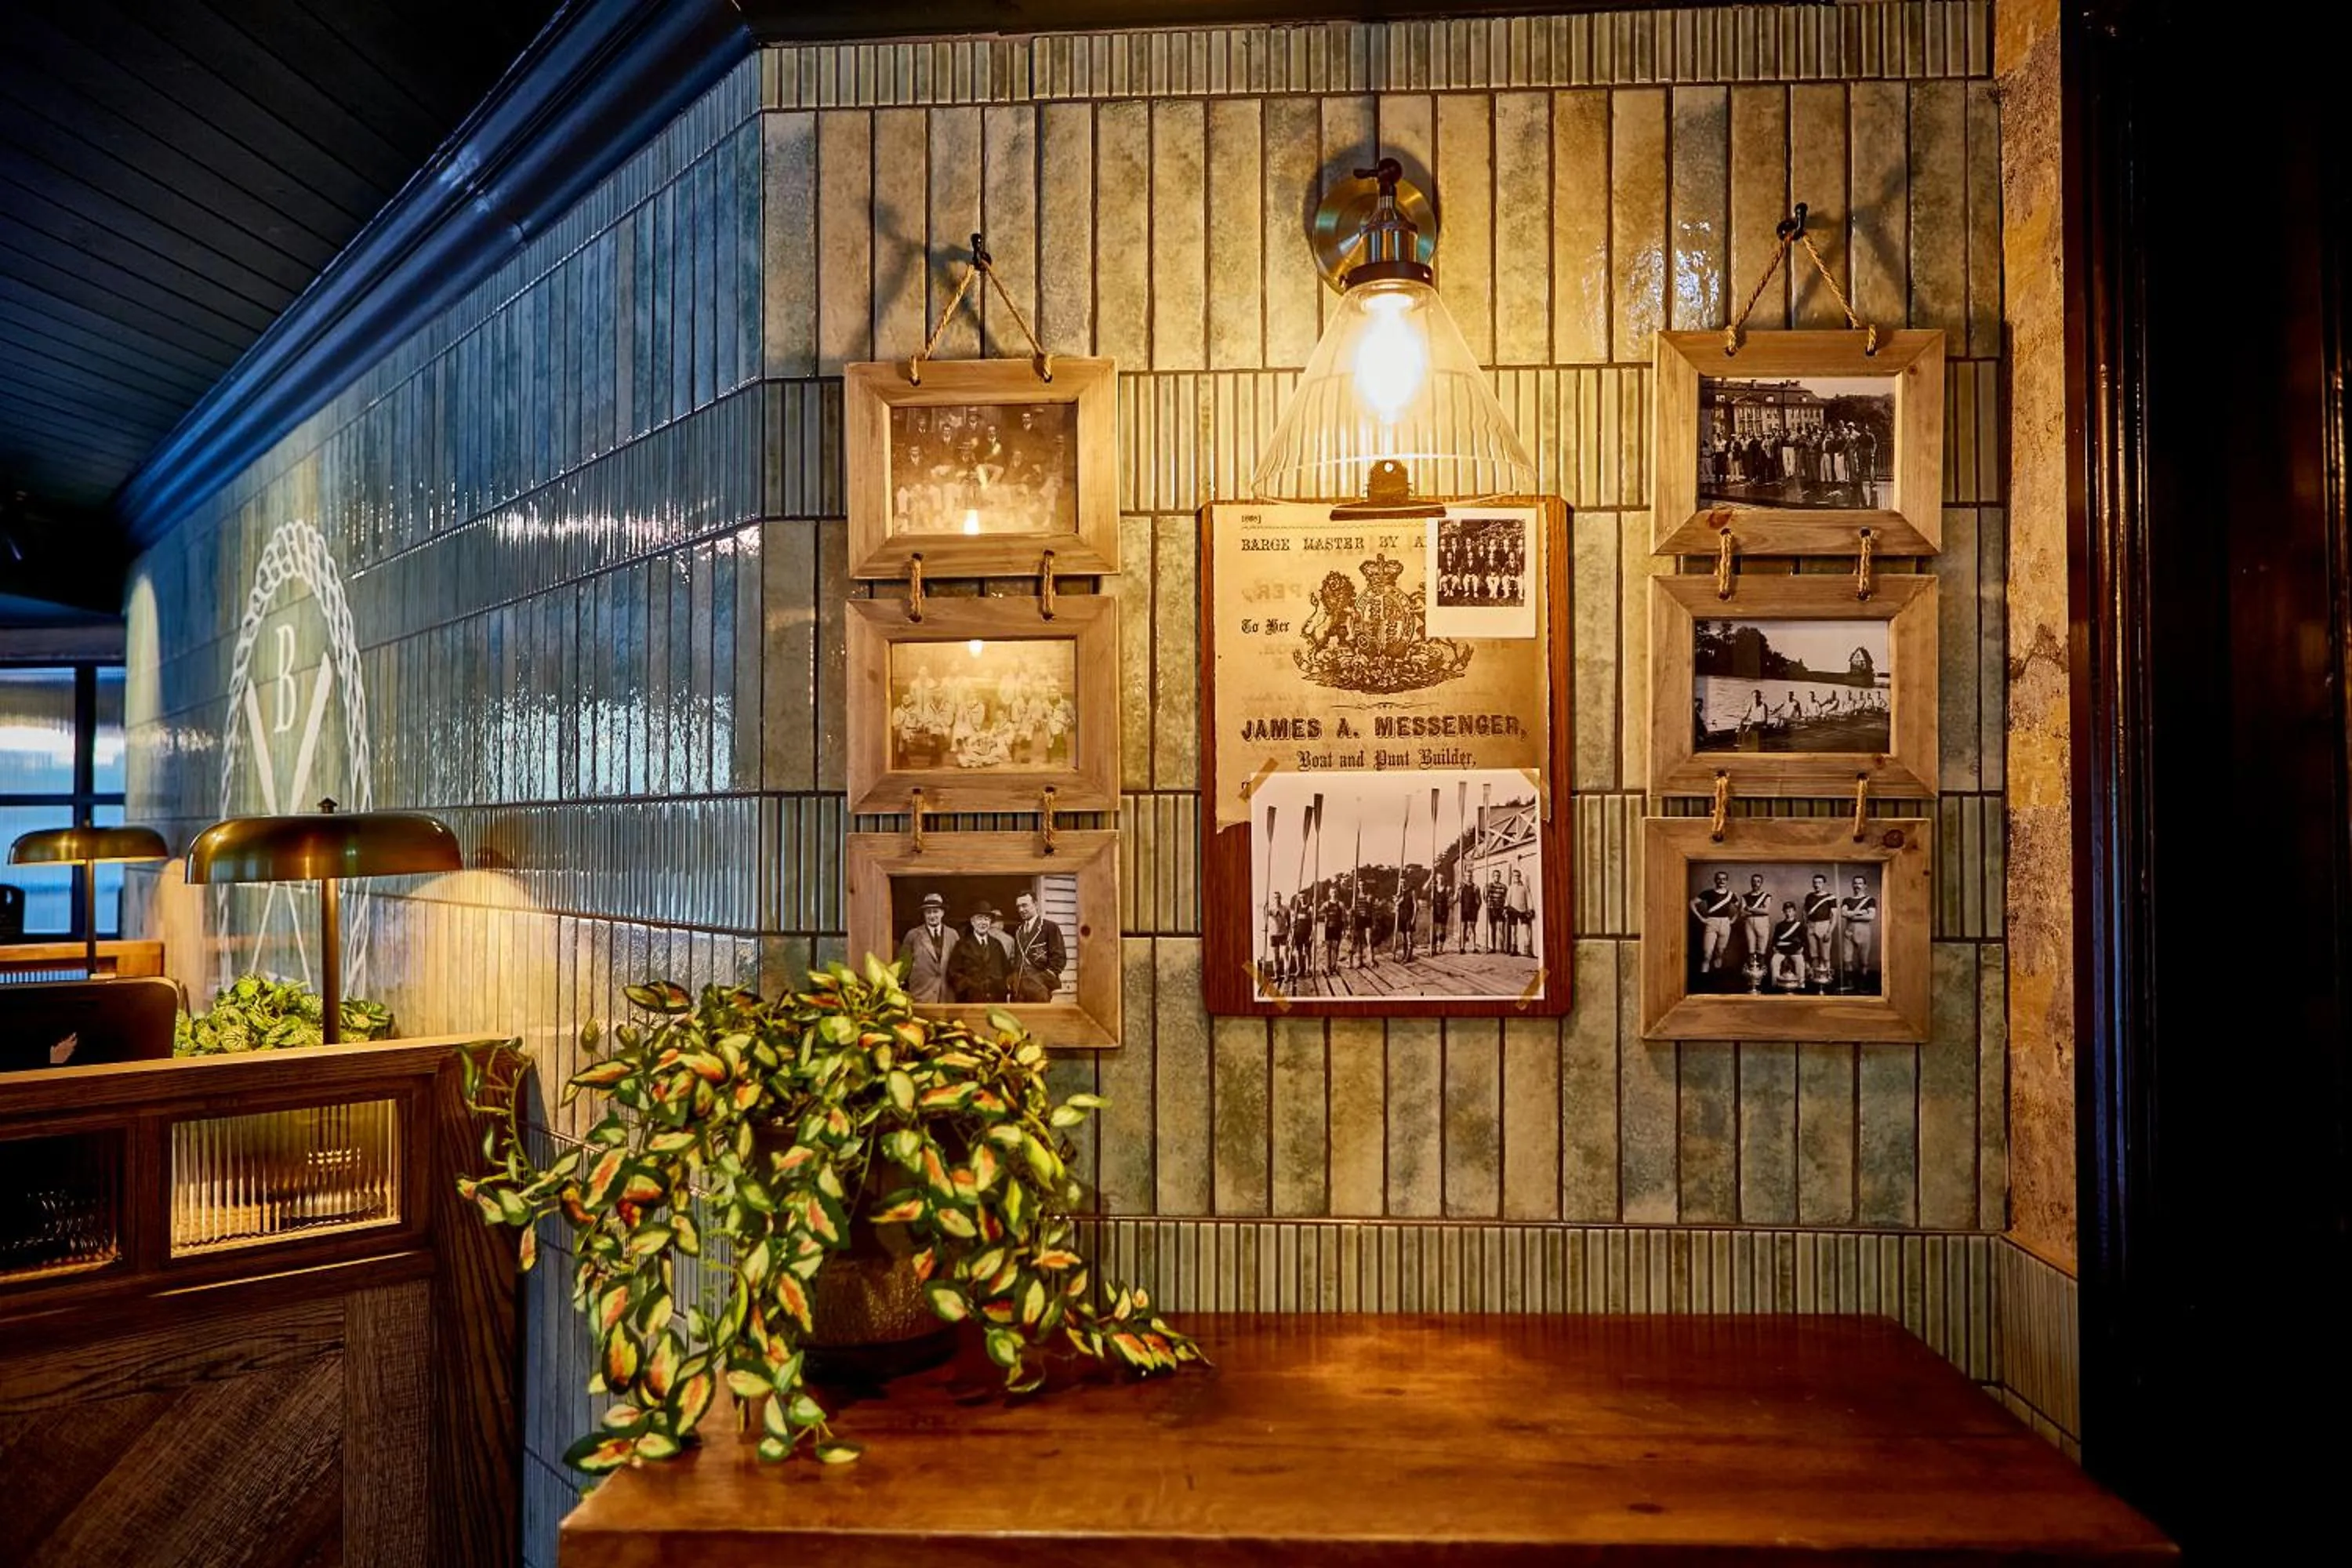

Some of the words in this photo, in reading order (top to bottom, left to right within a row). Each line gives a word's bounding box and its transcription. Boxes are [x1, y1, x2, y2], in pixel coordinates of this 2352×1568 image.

[1303, 536, 1365, 551] MASTER
[1379, 535, 1399, 548] BY
[1241, 618, 1259, 634] To
[1265, 617, 1290, 636] Her
[1241, 717, 1323, 741] JAMES
[1336, 717, 1360, 739] A.
[1374, 714, 1528, 741] MESSENGER,
[1296, 750, 1333, 771] Boat
[1339, 750, 1365, 768] and
[1374, 749, 1410, 771] Punt
[1417, 747, 1477, 771] Builder,
